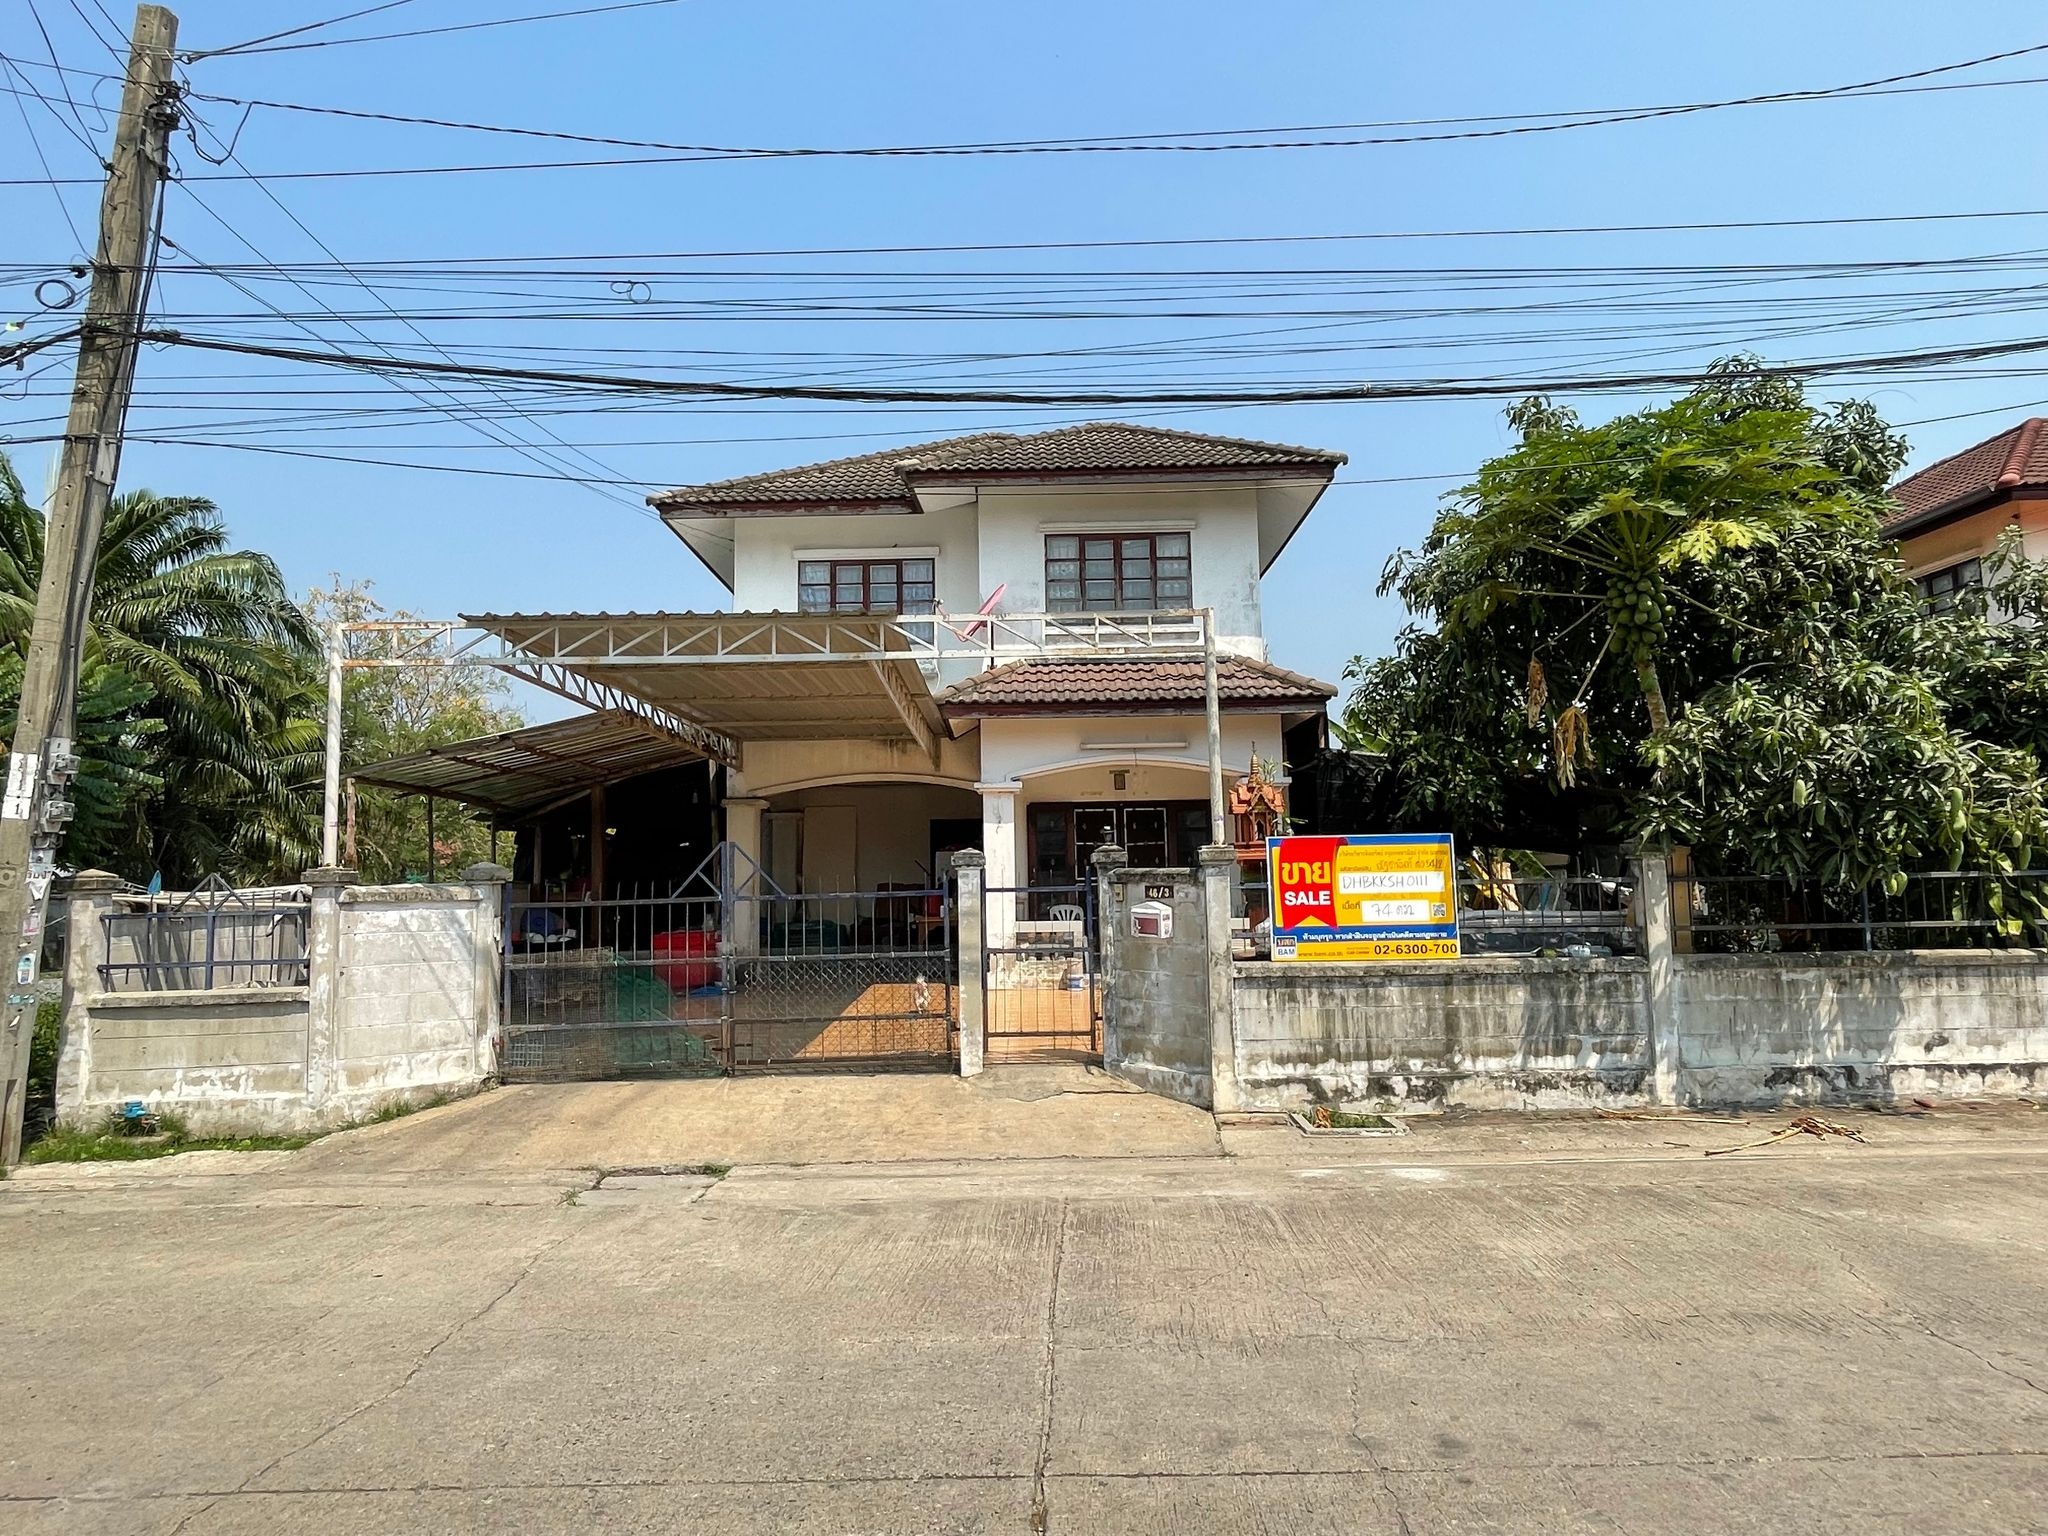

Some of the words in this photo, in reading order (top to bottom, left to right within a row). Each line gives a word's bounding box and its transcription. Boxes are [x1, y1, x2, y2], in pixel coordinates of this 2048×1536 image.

[1281, 862, 1331, 885] ขาย
[1284, 890, 1331, 906] SALE
[1371, 903, 1393, 917] 74
[1277, 948, 1295, 956] BAM
[1374, 943, 1457, 955] 02-6300-700
